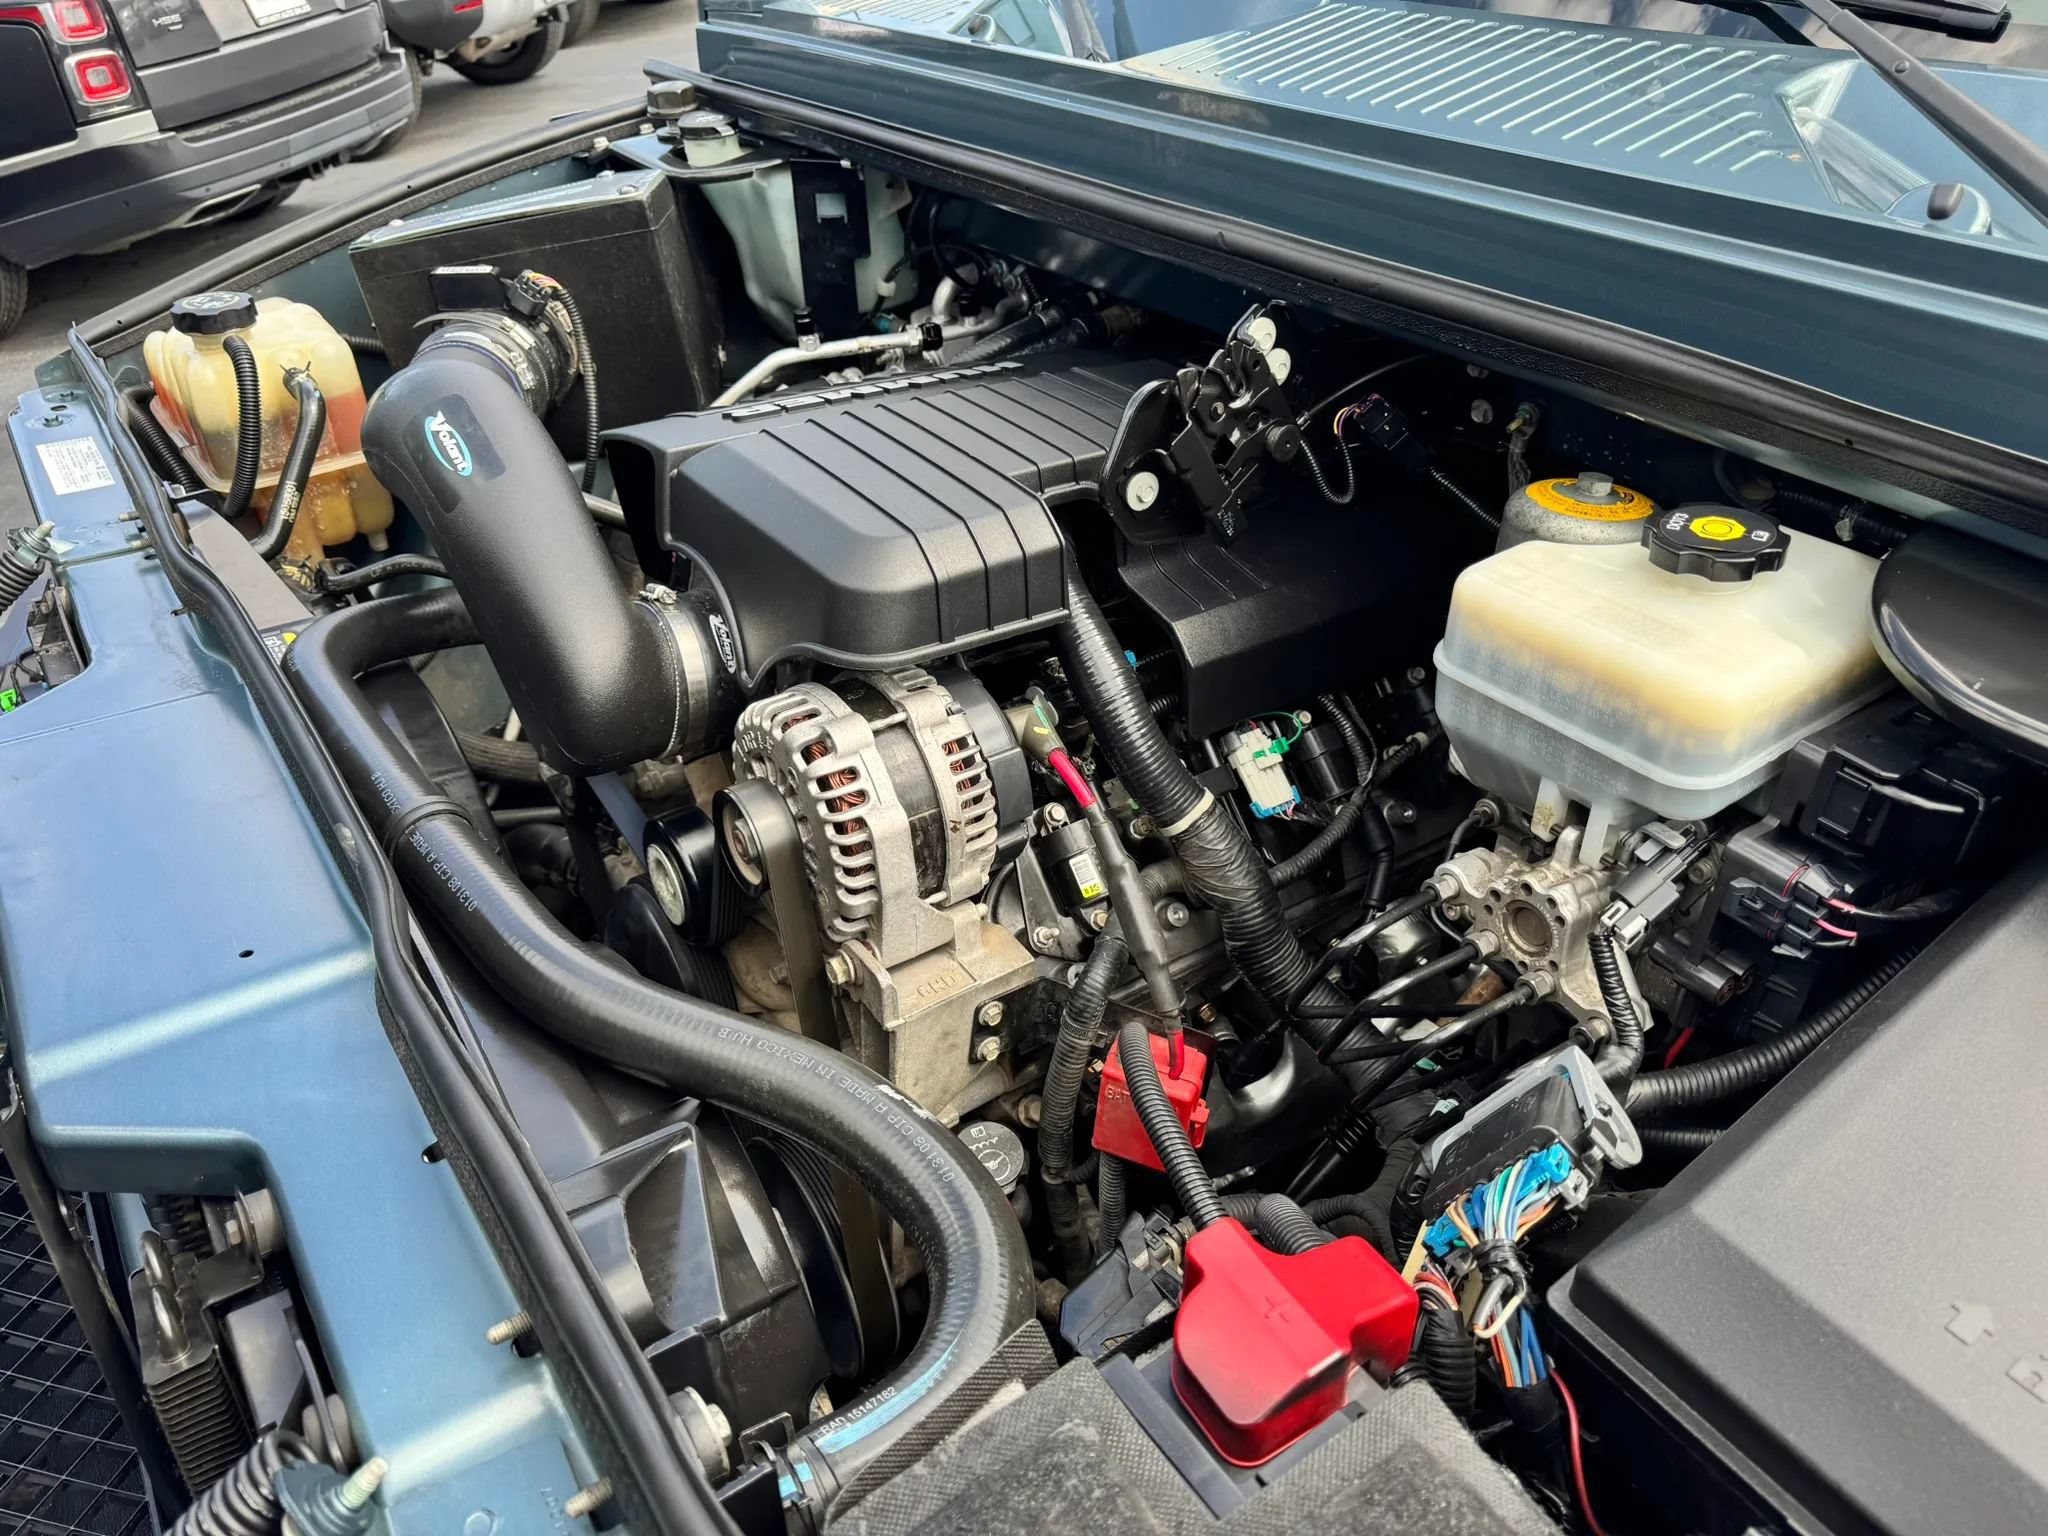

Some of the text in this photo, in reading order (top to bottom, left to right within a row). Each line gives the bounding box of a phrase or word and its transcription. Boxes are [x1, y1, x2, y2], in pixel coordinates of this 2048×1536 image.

[424, 410, 472, 476] Volant
[1666, 512, 1689, 531] DOT3
[709, 614, 736, 674] Volant
[432, 862, 451, 880] CIP
[757, 1038, 815, 1070] MEXICO
[815, 1064, 836, 1081] IN
[838, 1077, 876, 1106] MADE
[887, 1114, 914, 1136] CIP
[847, 1386, 898, 1421] 15147182
